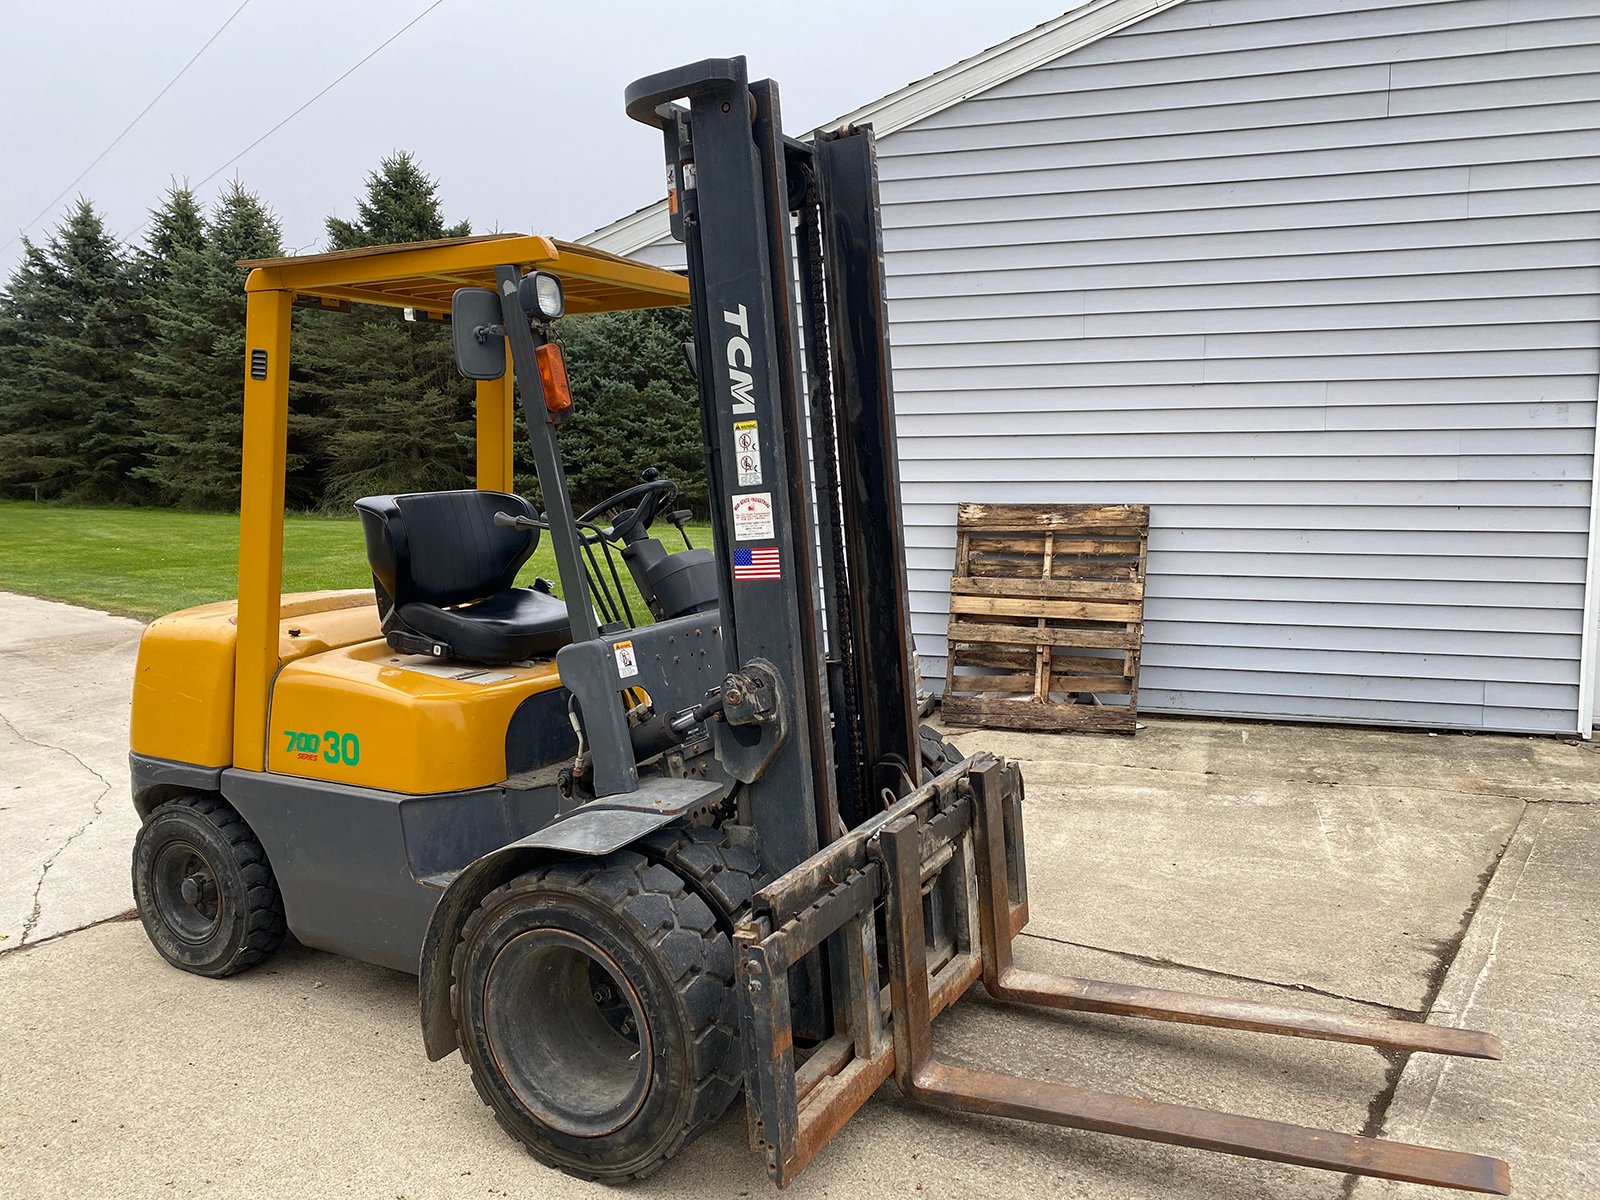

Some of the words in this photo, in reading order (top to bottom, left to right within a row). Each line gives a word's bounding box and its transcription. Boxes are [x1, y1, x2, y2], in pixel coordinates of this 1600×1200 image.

[723, 303, 756, 415] TCM
[283, 730, 320, 753] 700
[323, 730, 360, 767] 30
[297, 753, 318, 762] SERIES
